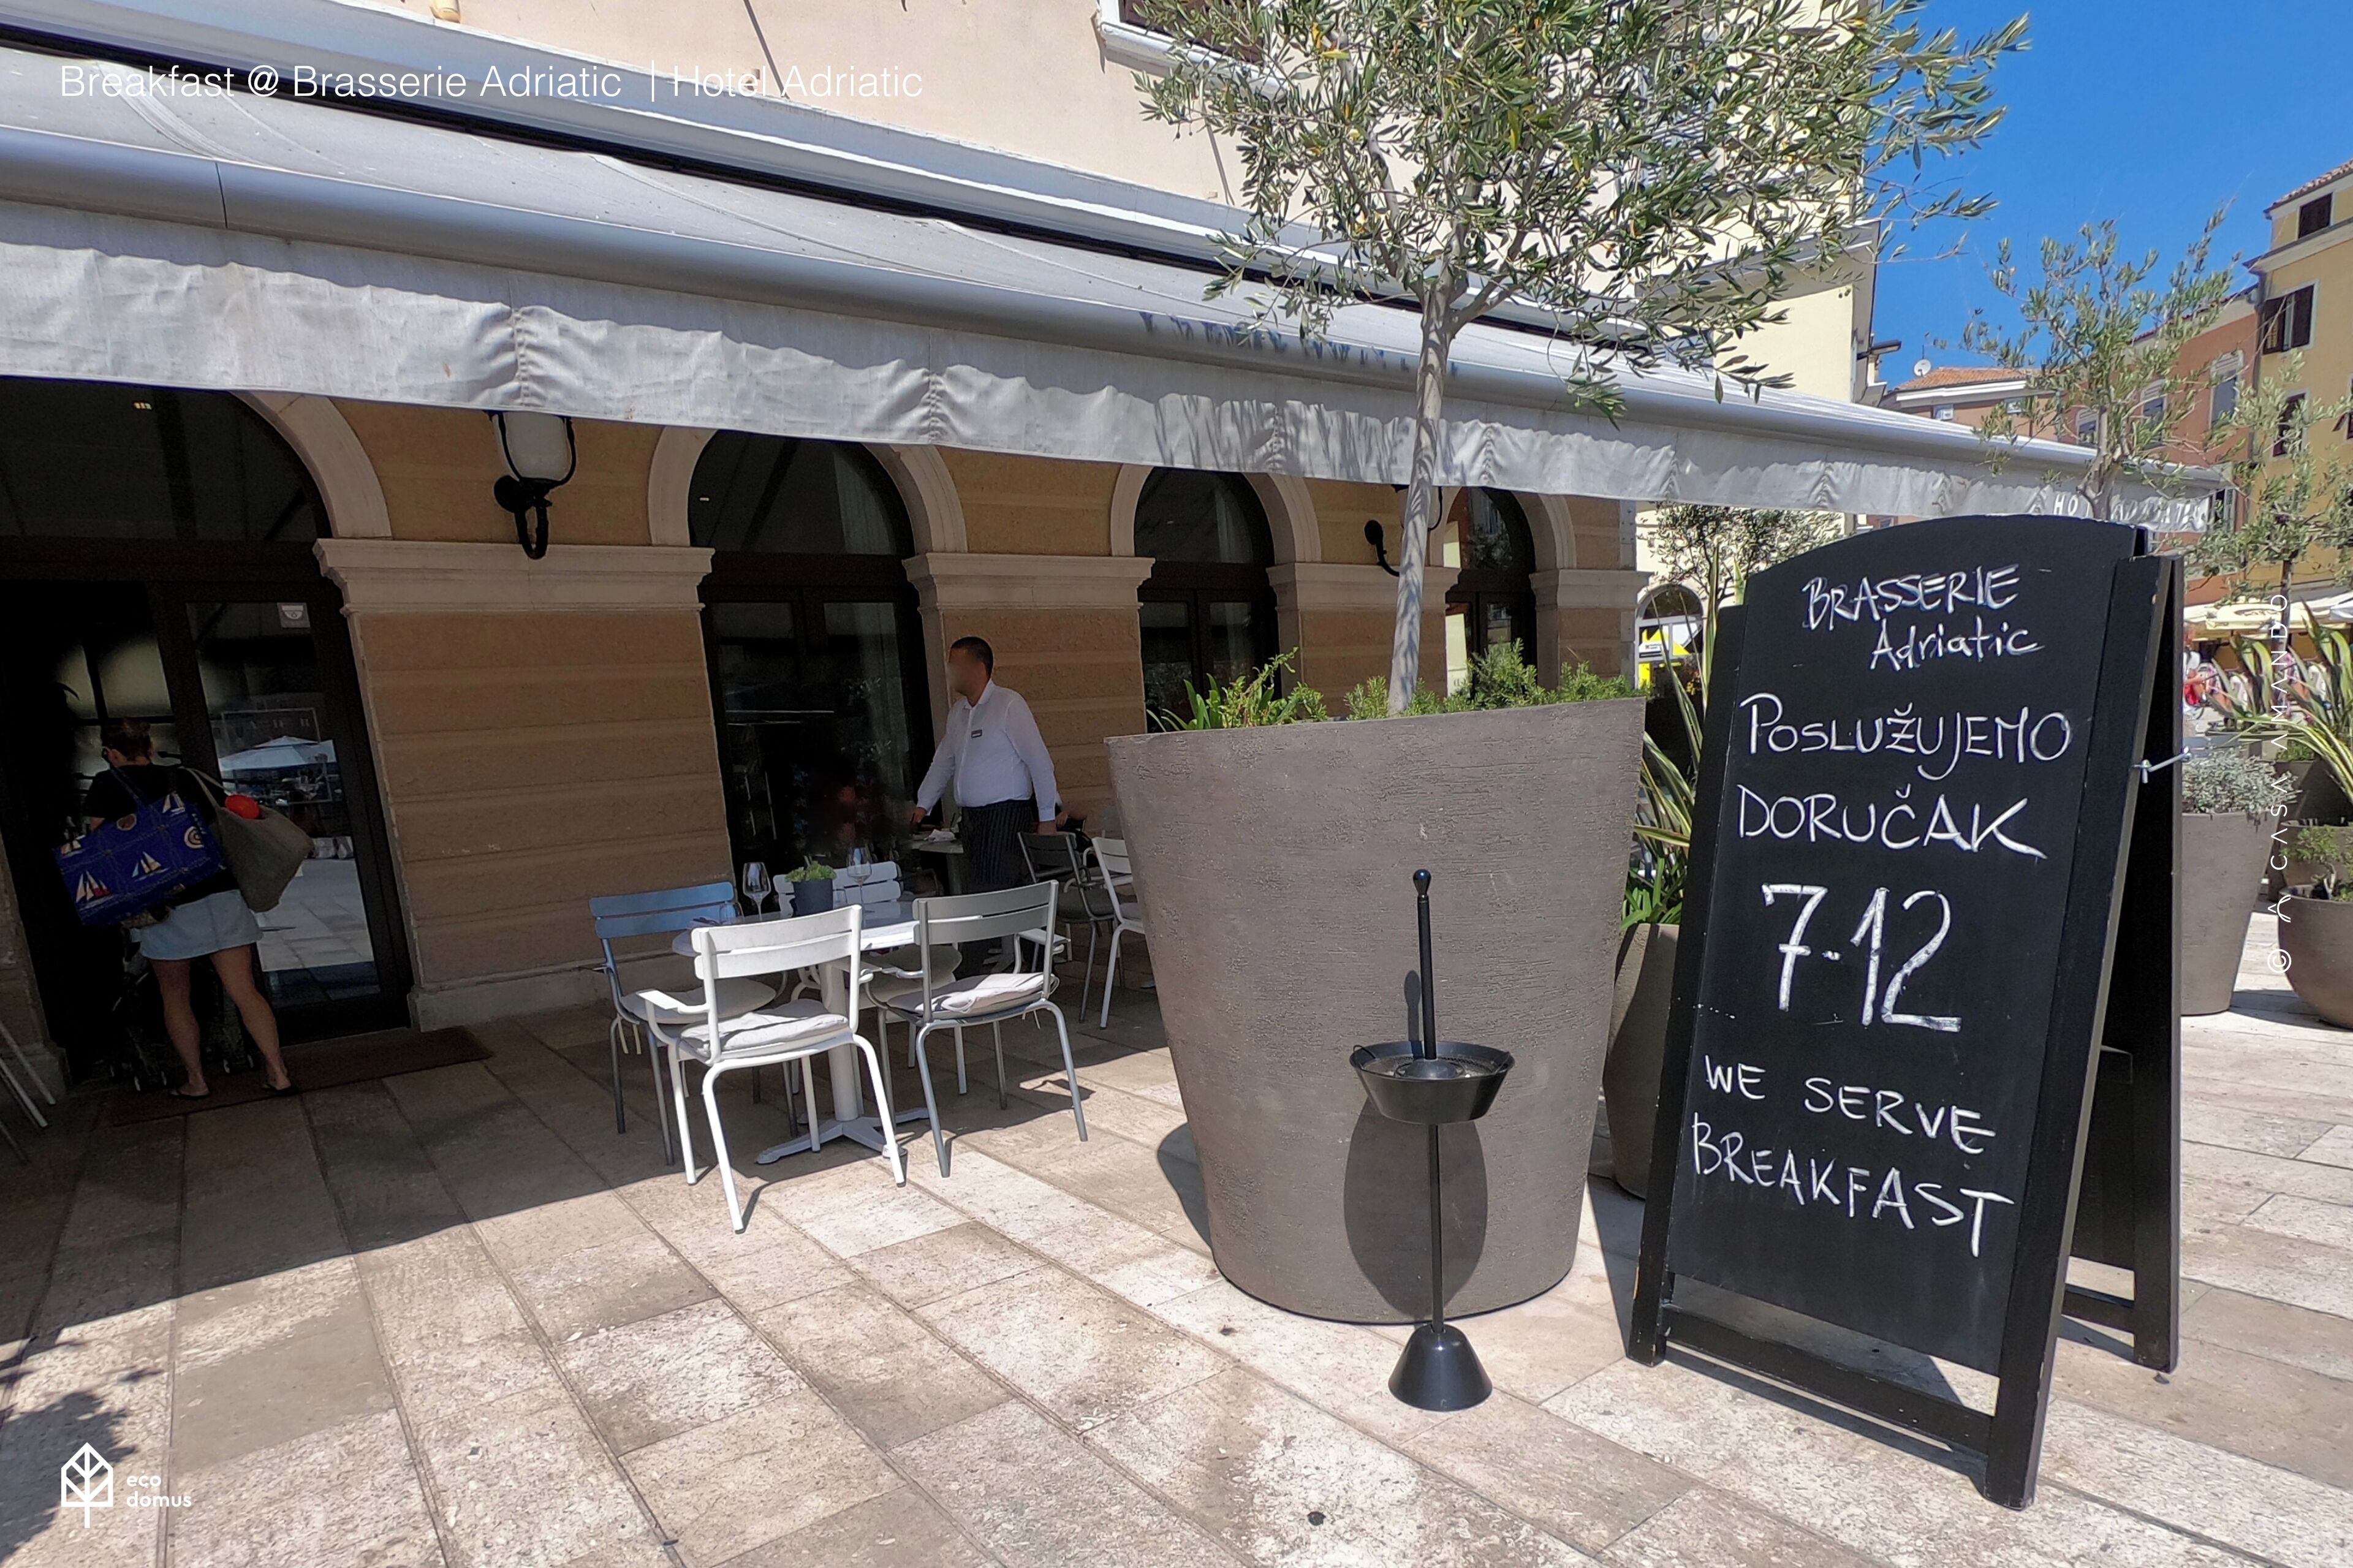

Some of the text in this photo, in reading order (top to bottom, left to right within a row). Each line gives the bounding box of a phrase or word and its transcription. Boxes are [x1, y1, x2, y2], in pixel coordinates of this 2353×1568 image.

[1802, 563, 2020, 631] BRASSERIE
[1870, 615, 2045, 672] Adriatic
[1737, 784, 2047, 860] DORUČAK
[1704, 1055, 1996, 1155] WE SERVE
[1692, 1112, 2015, 1257] BREAKFAST
